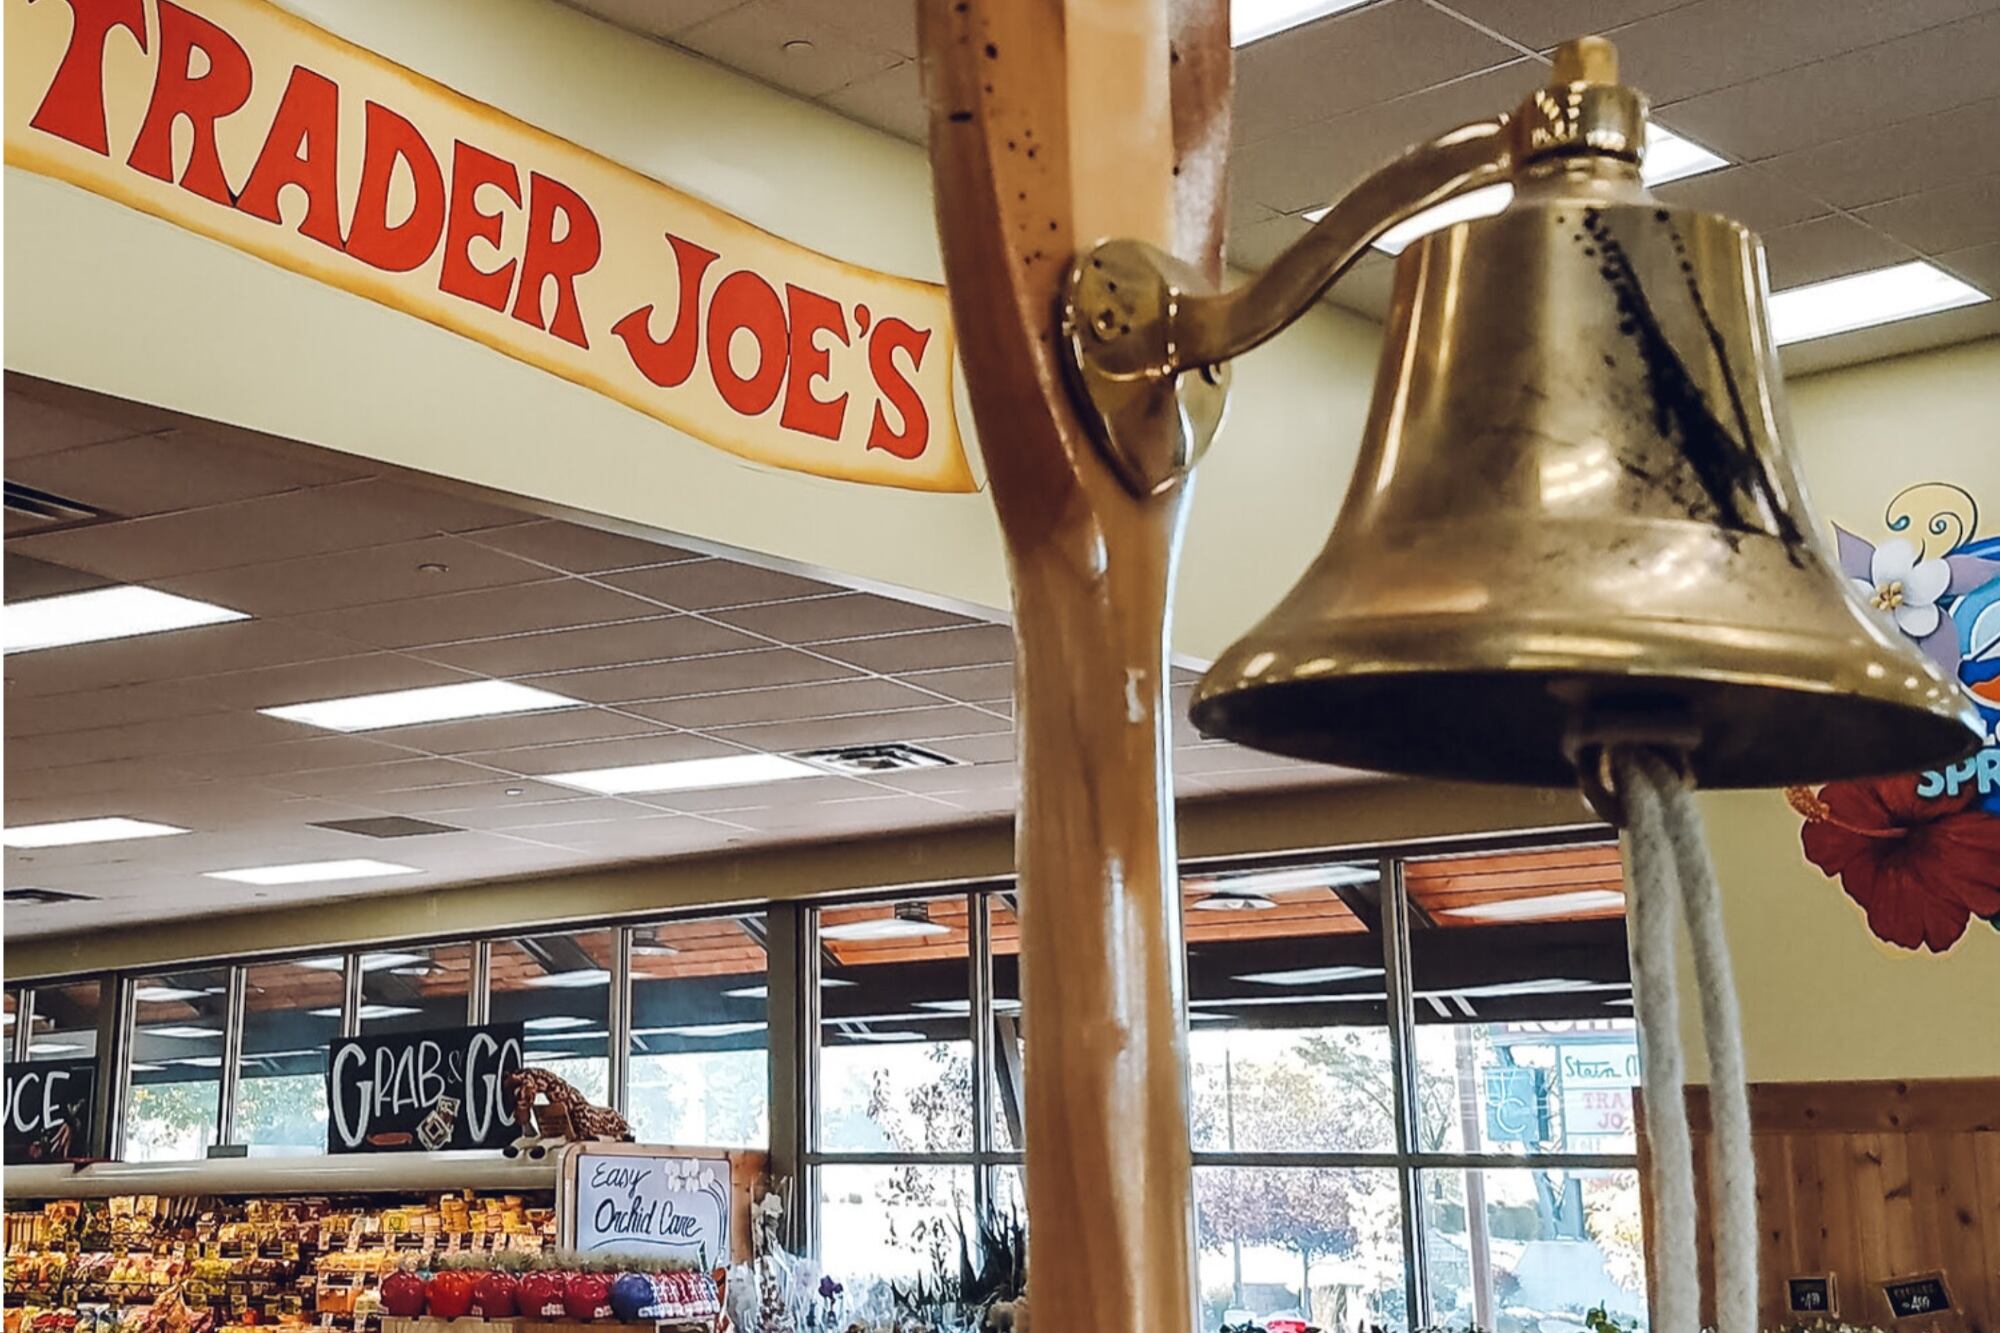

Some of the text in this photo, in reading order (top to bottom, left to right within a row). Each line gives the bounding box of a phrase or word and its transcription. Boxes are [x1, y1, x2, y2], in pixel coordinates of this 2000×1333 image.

[29, 0, 932, 460] TRADER JOE'S
[1564, 1055, 1622, 1078] Stein
[333, 1040, 446, 1147] GRAB
[466, 1032, 522, 1143] GO
[591, 1162, 652, 1198] Easy
[595, 1195, 704, 1237] Orchid Care
